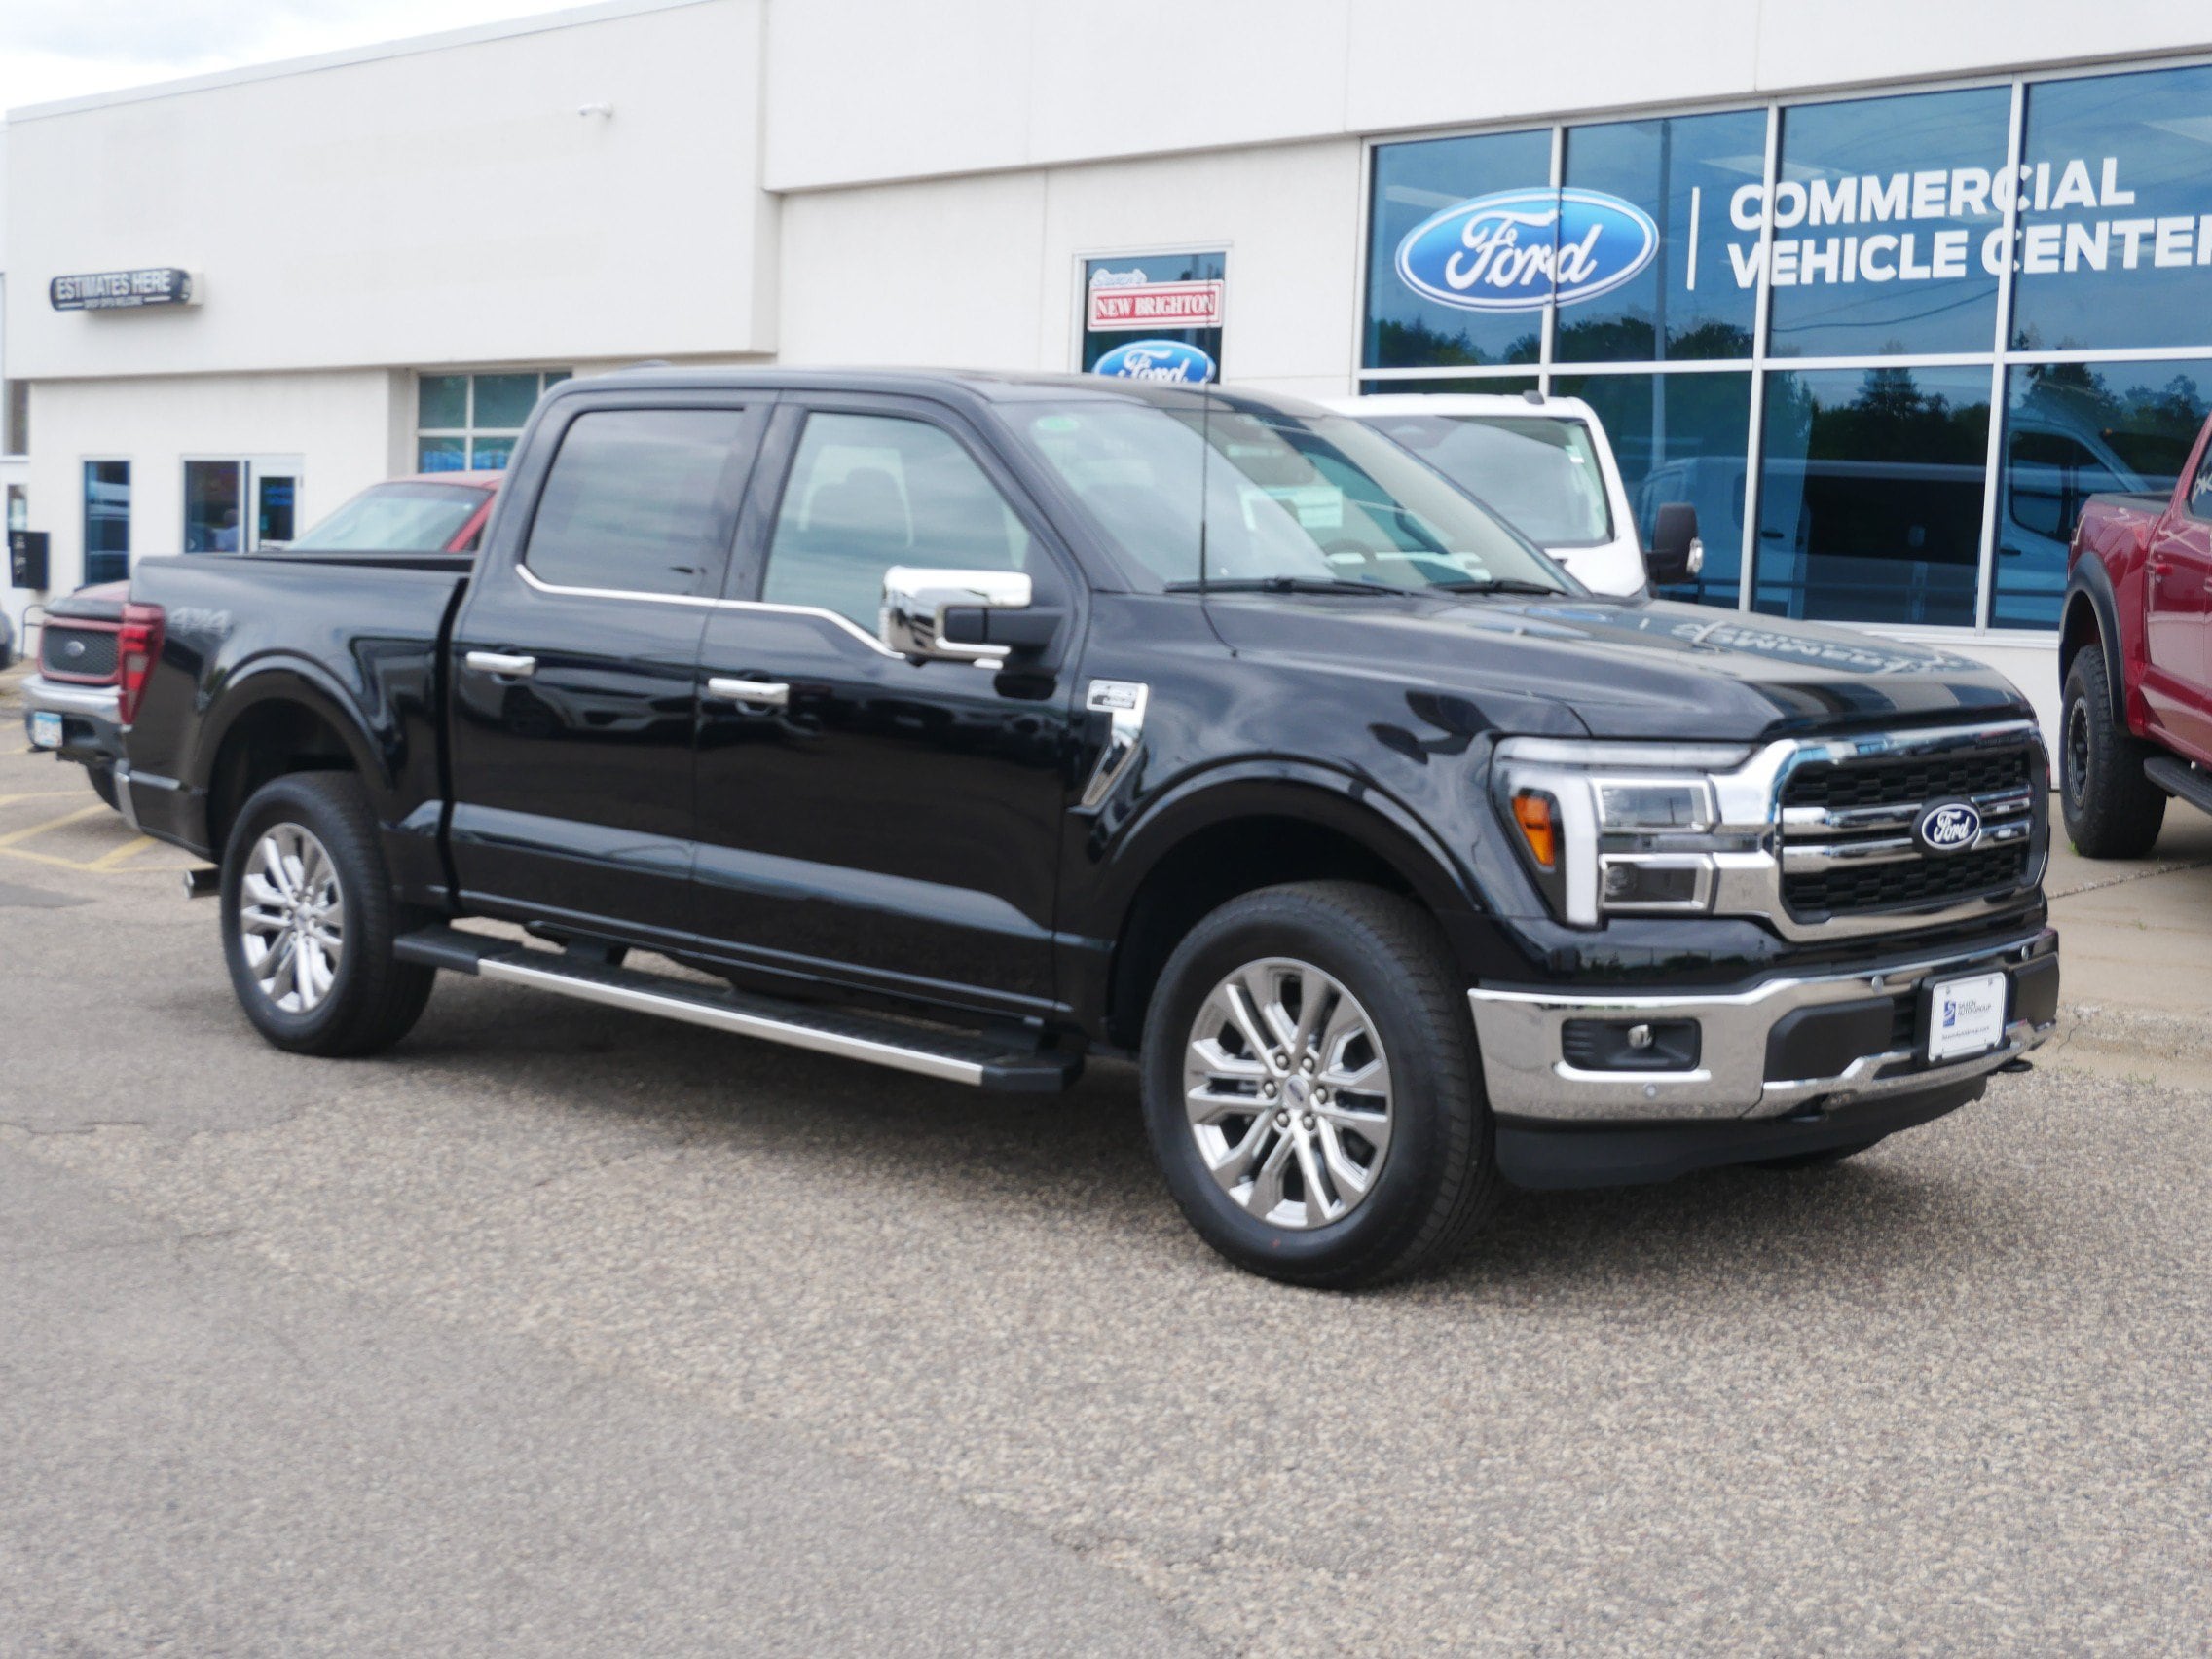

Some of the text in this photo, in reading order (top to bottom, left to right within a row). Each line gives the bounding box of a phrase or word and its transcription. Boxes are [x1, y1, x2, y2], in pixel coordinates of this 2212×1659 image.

[1729, 157, 2135, 231] COMMERCIAL
[1445, 208, 1604, 290] Ford
[1727, 230, 1969, 289] VEHICLE
[56, 270, 172, 301] ESTIMATES HERE
[1097, 294, 1214, 318] NEW BRIGHTON
[1117, 349, 1192, 383] Ford
[1933, 809, 1970, 844] Ford
